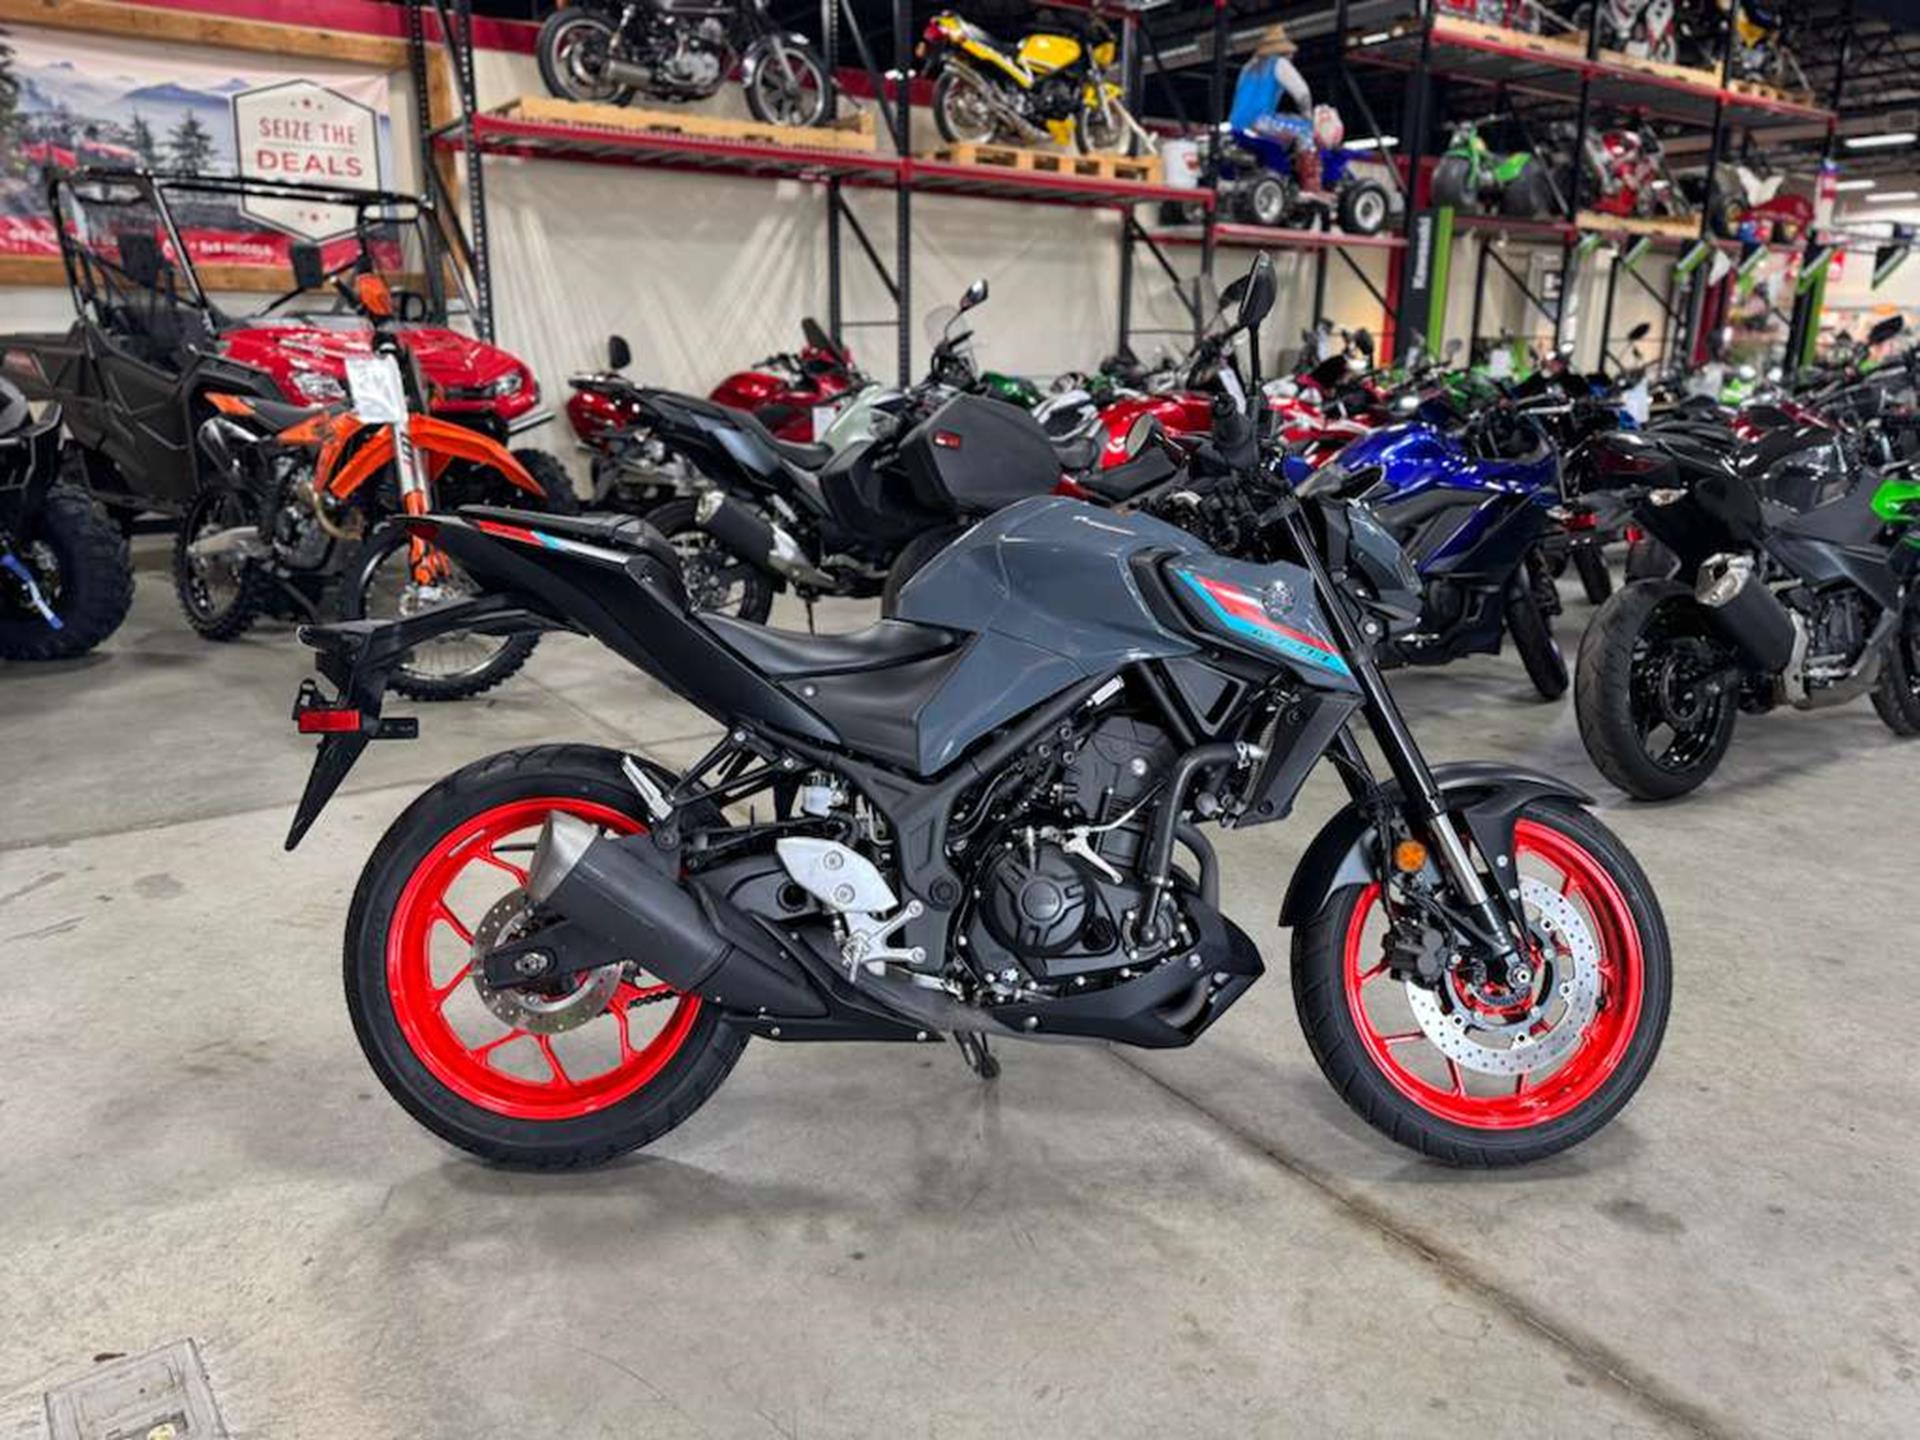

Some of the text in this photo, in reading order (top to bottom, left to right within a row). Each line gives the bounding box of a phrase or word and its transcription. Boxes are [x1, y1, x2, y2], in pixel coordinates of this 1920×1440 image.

[258, 116, 358, 145] SEIZE THE
[256, 149, 363, 177] DEALS
